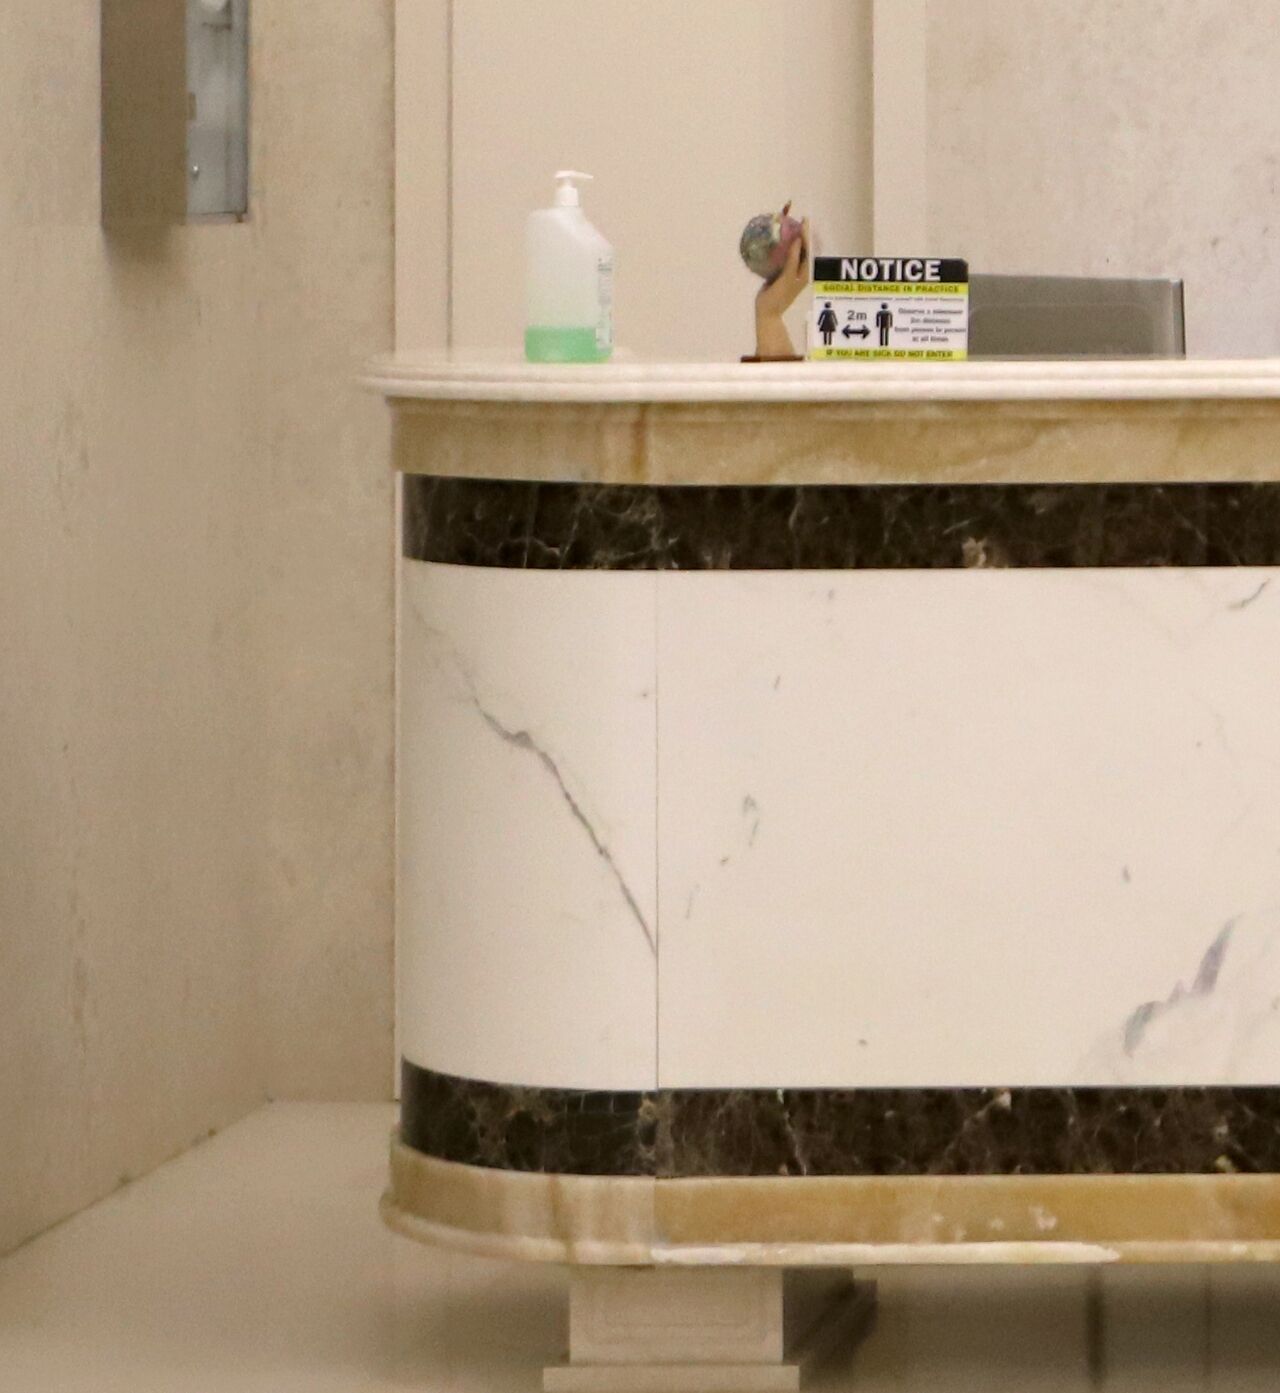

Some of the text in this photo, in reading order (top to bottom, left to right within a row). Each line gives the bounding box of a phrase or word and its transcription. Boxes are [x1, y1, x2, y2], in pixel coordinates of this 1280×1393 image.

[841, 258, 941, 281] NOTICE
[823, 284, 853, 292] SOCIAL
[857, 284, 900, 293] DISTANCE
[915, 285, 959, 293] PRACTICE
